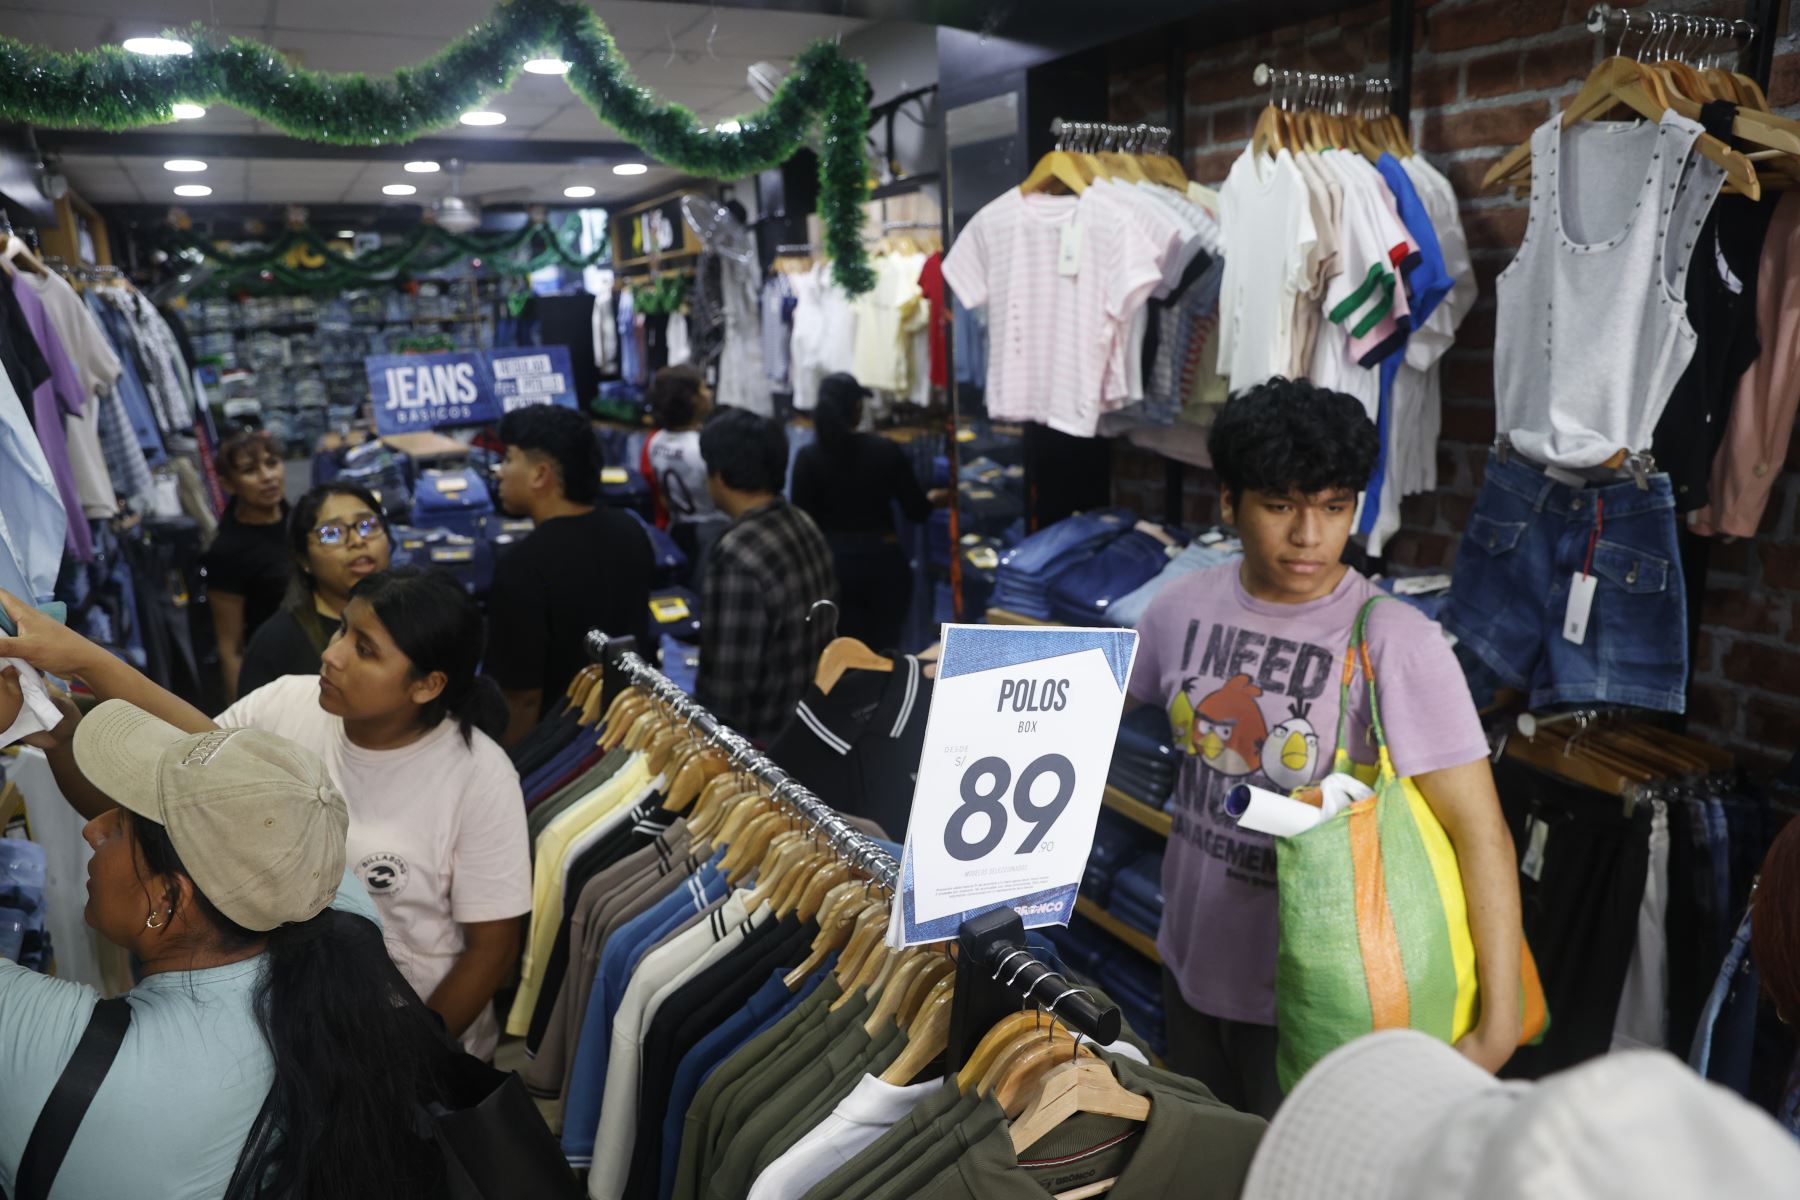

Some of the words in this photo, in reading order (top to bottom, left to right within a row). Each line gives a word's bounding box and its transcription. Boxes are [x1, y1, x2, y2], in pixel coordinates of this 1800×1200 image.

[385, 362, 478, 410] JEANS
[1180, 618, 1200, 671] I
[1198, 622, 1335, 699] NEED
[997, 678, 1070, 713] POLOS
[1017, 720, 1038, 733] BOX
[944, 753, 1076, 862] 89
[361, 855, 407, 875] BILLABONG
[1055, 1168, 1096, 1185] BRONCO
